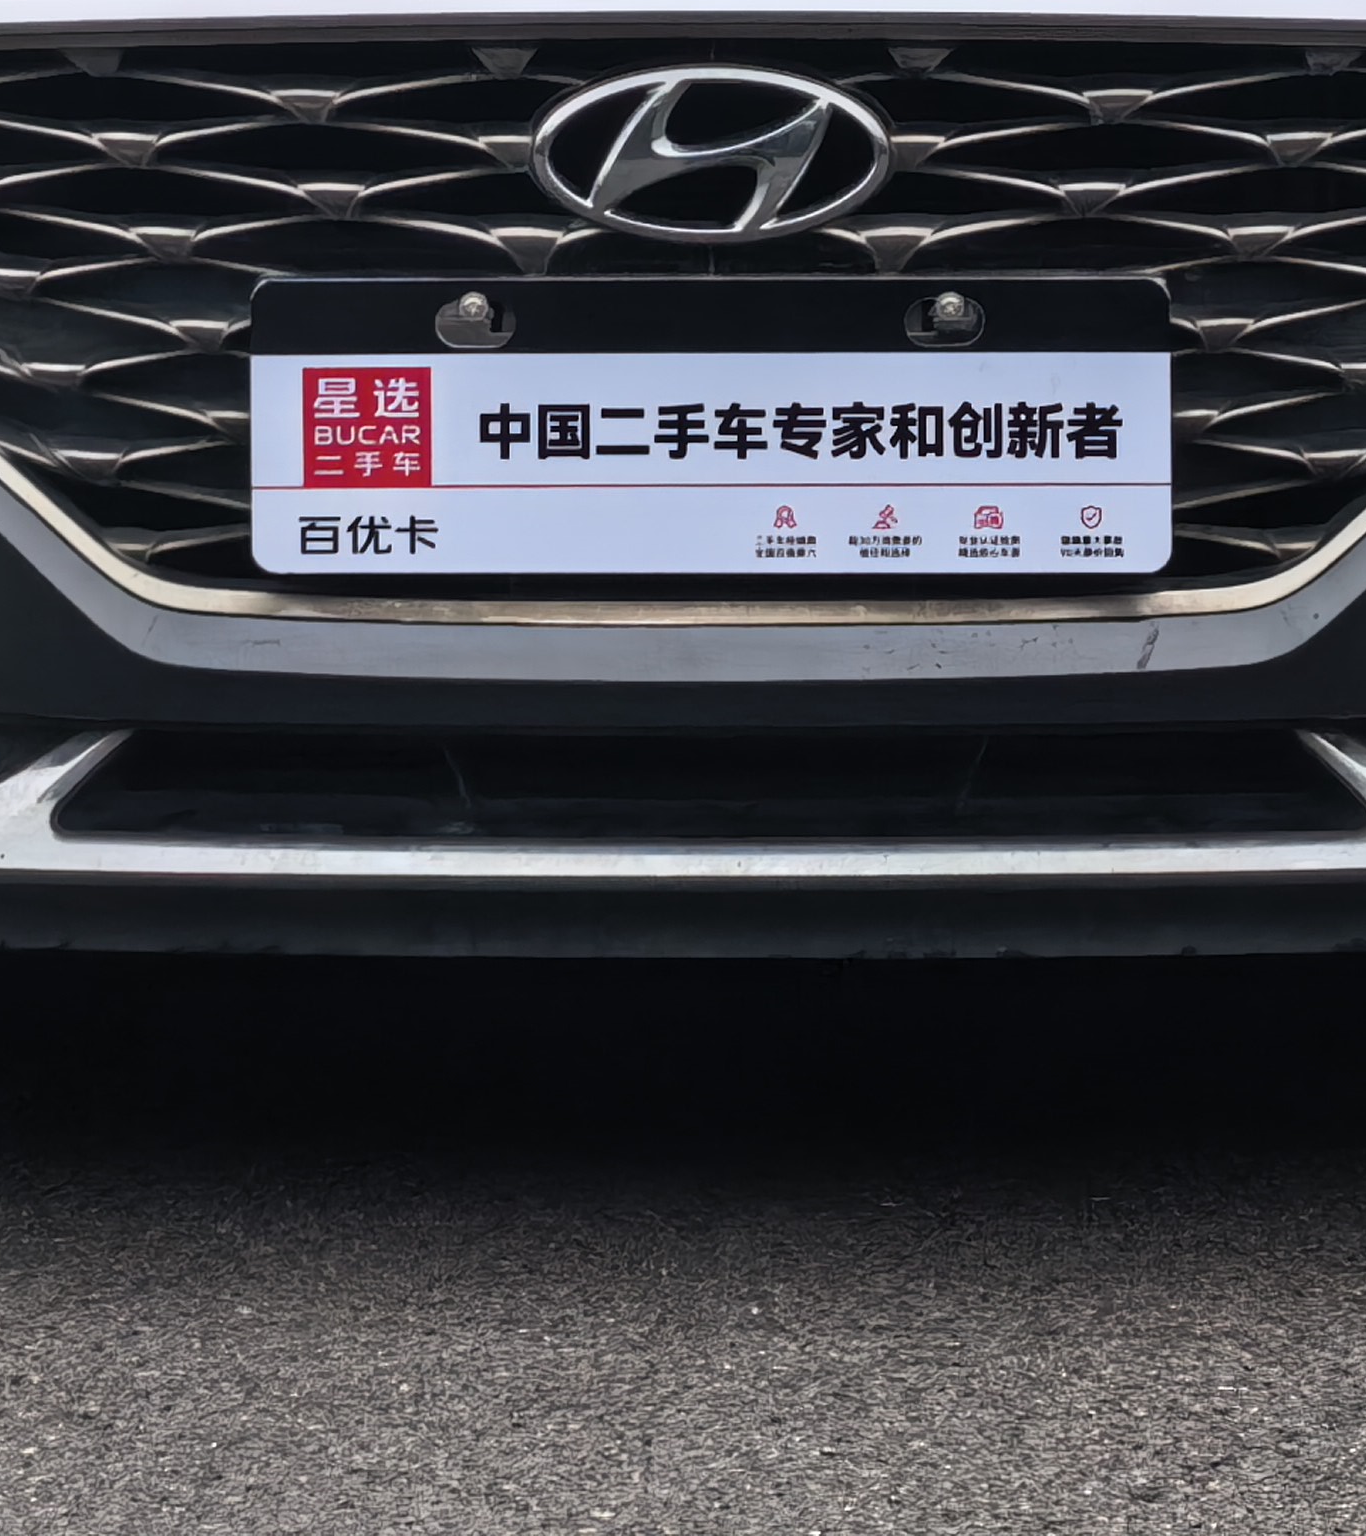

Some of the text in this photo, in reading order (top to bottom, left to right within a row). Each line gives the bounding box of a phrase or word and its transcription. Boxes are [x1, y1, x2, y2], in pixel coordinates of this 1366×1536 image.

[313, 377, 420, 419] 星选
[314, 424, 421, 446] BUCAR
[479, 401, 1124, 461] 中国二手车专家和创新者
[314, 451, 421, 477] 二手车
[298, 515, 439, 555] 百优卡
